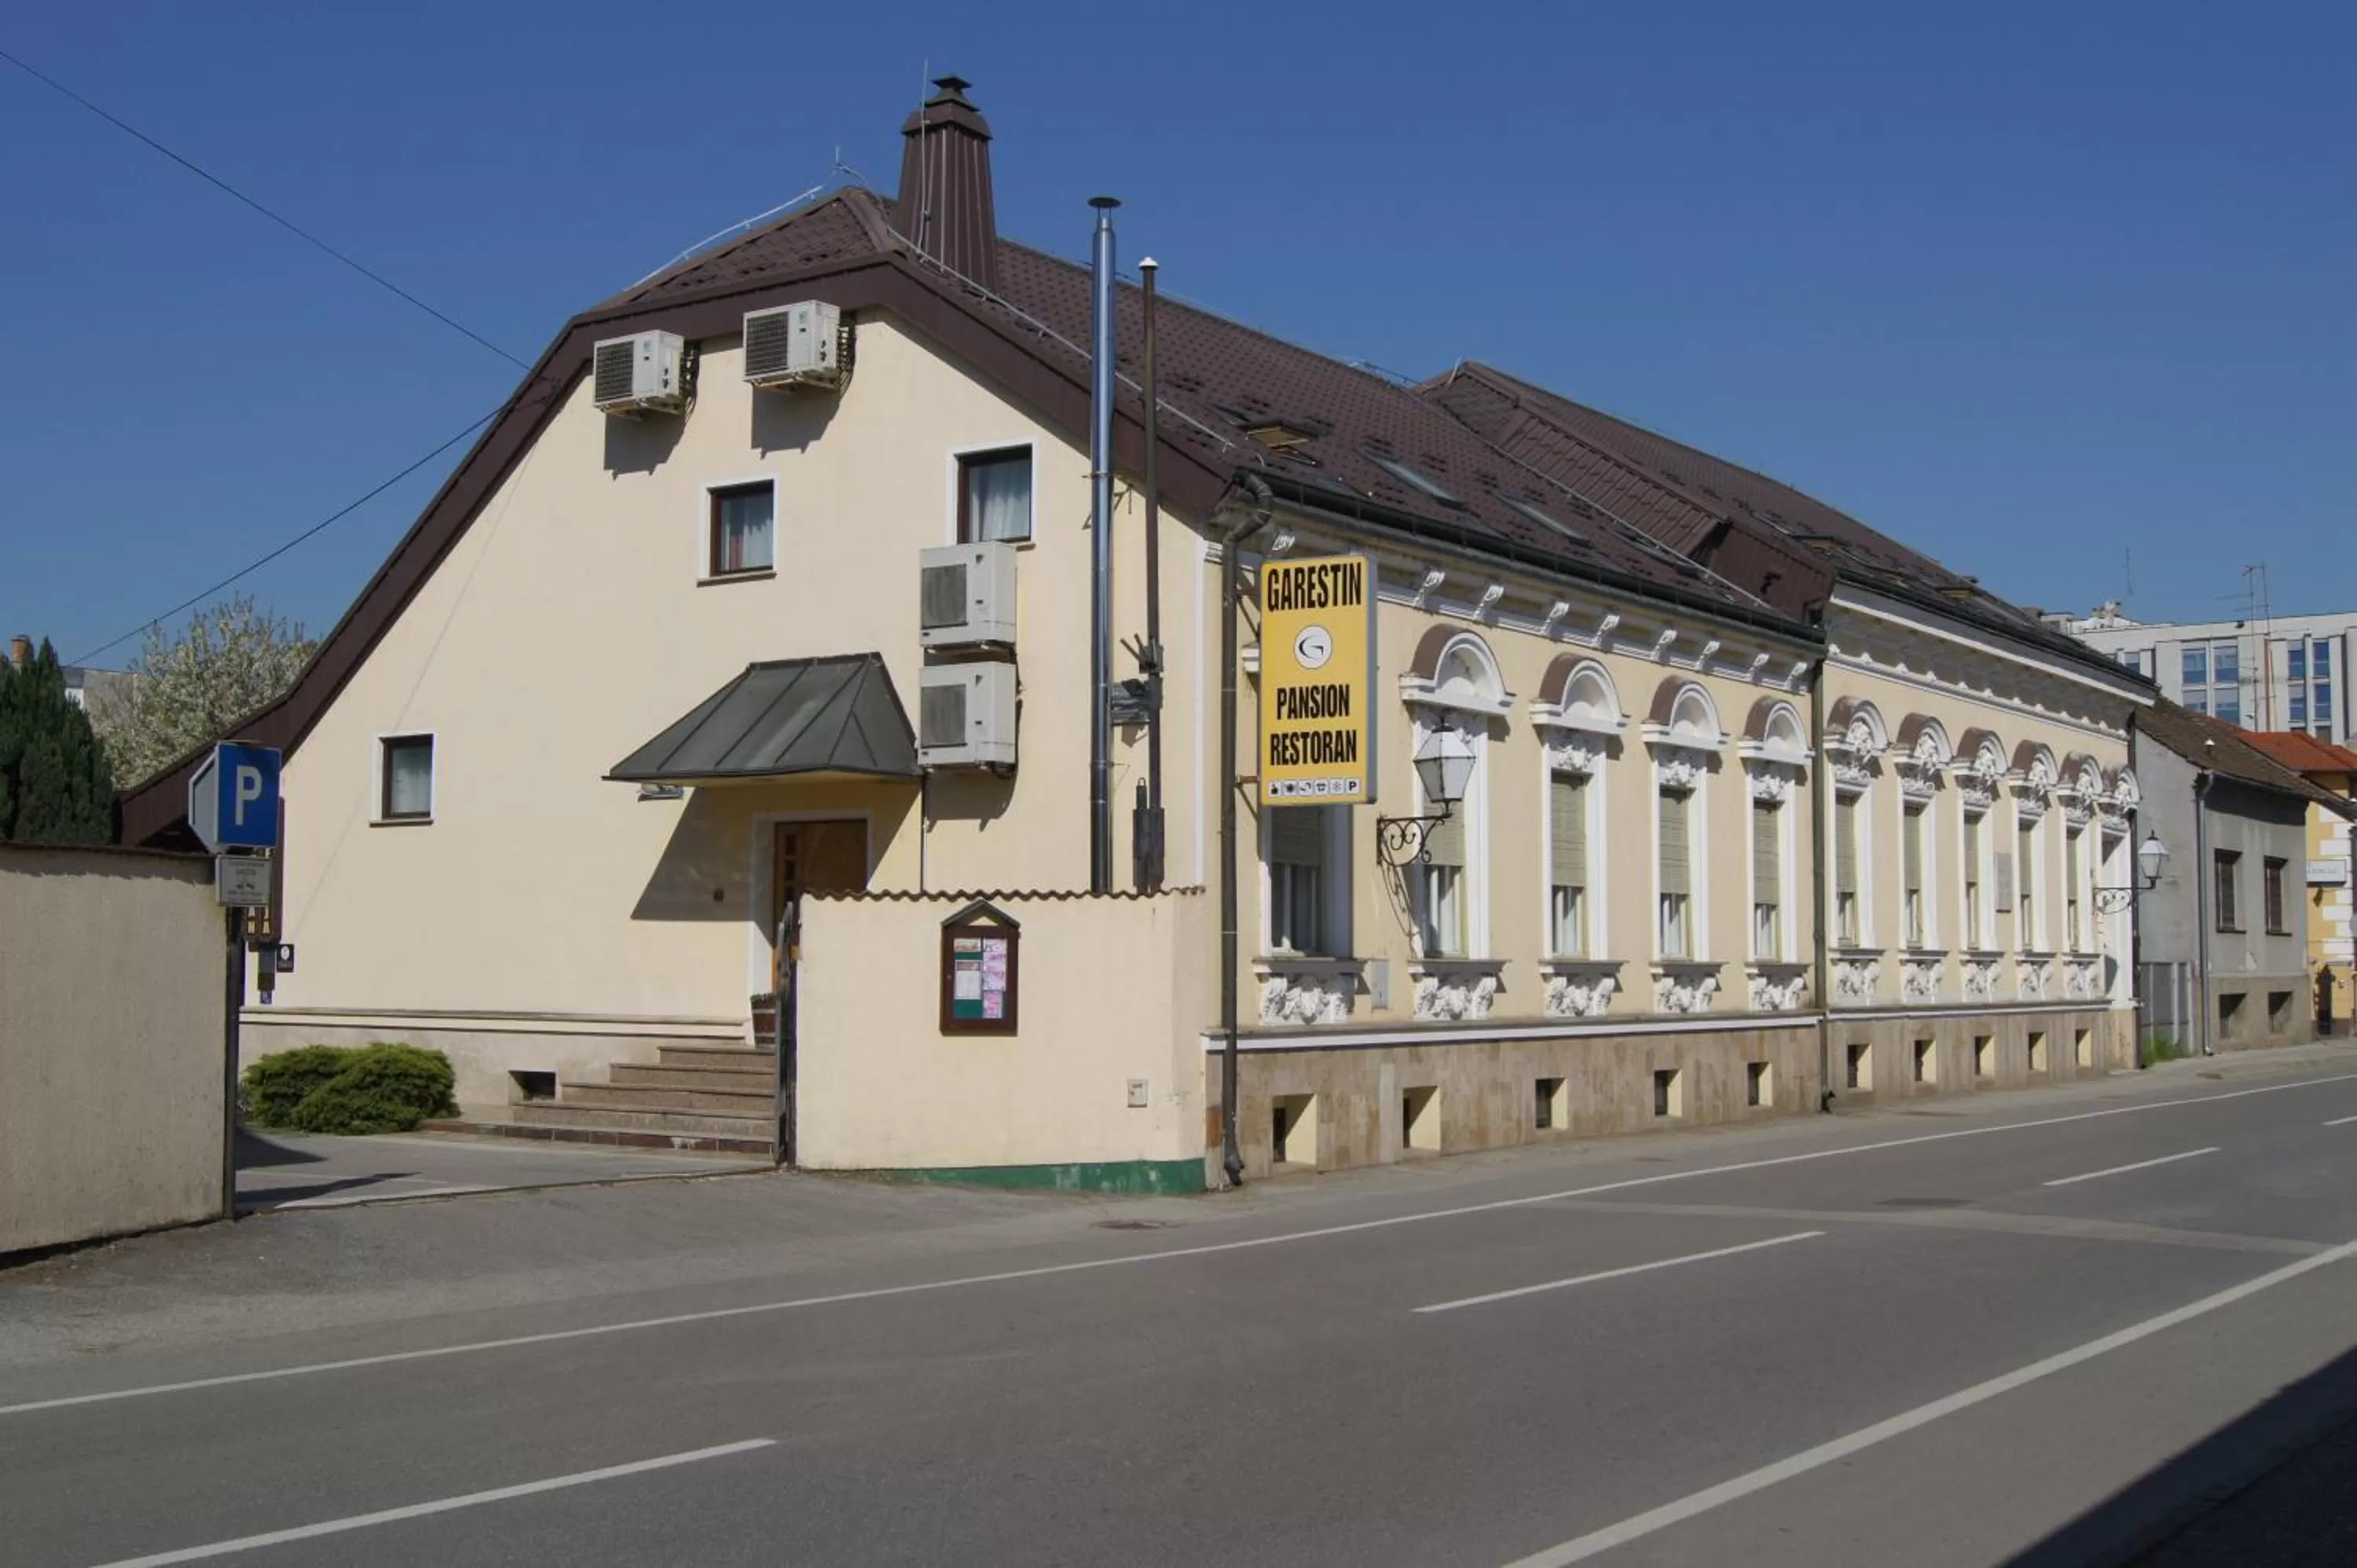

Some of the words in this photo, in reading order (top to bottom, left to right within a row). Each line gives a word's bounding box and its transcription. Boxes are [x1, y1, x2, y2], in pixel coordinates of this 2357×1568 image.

[1267, 562, 1362, 612] GARESTIN
[1277, 683, 1350, 720] PANSION
[1270, 729, 1358, 767] RESTORAN
[236, 765, 262, 826] P
[1349, 781, 1357, 791] P
